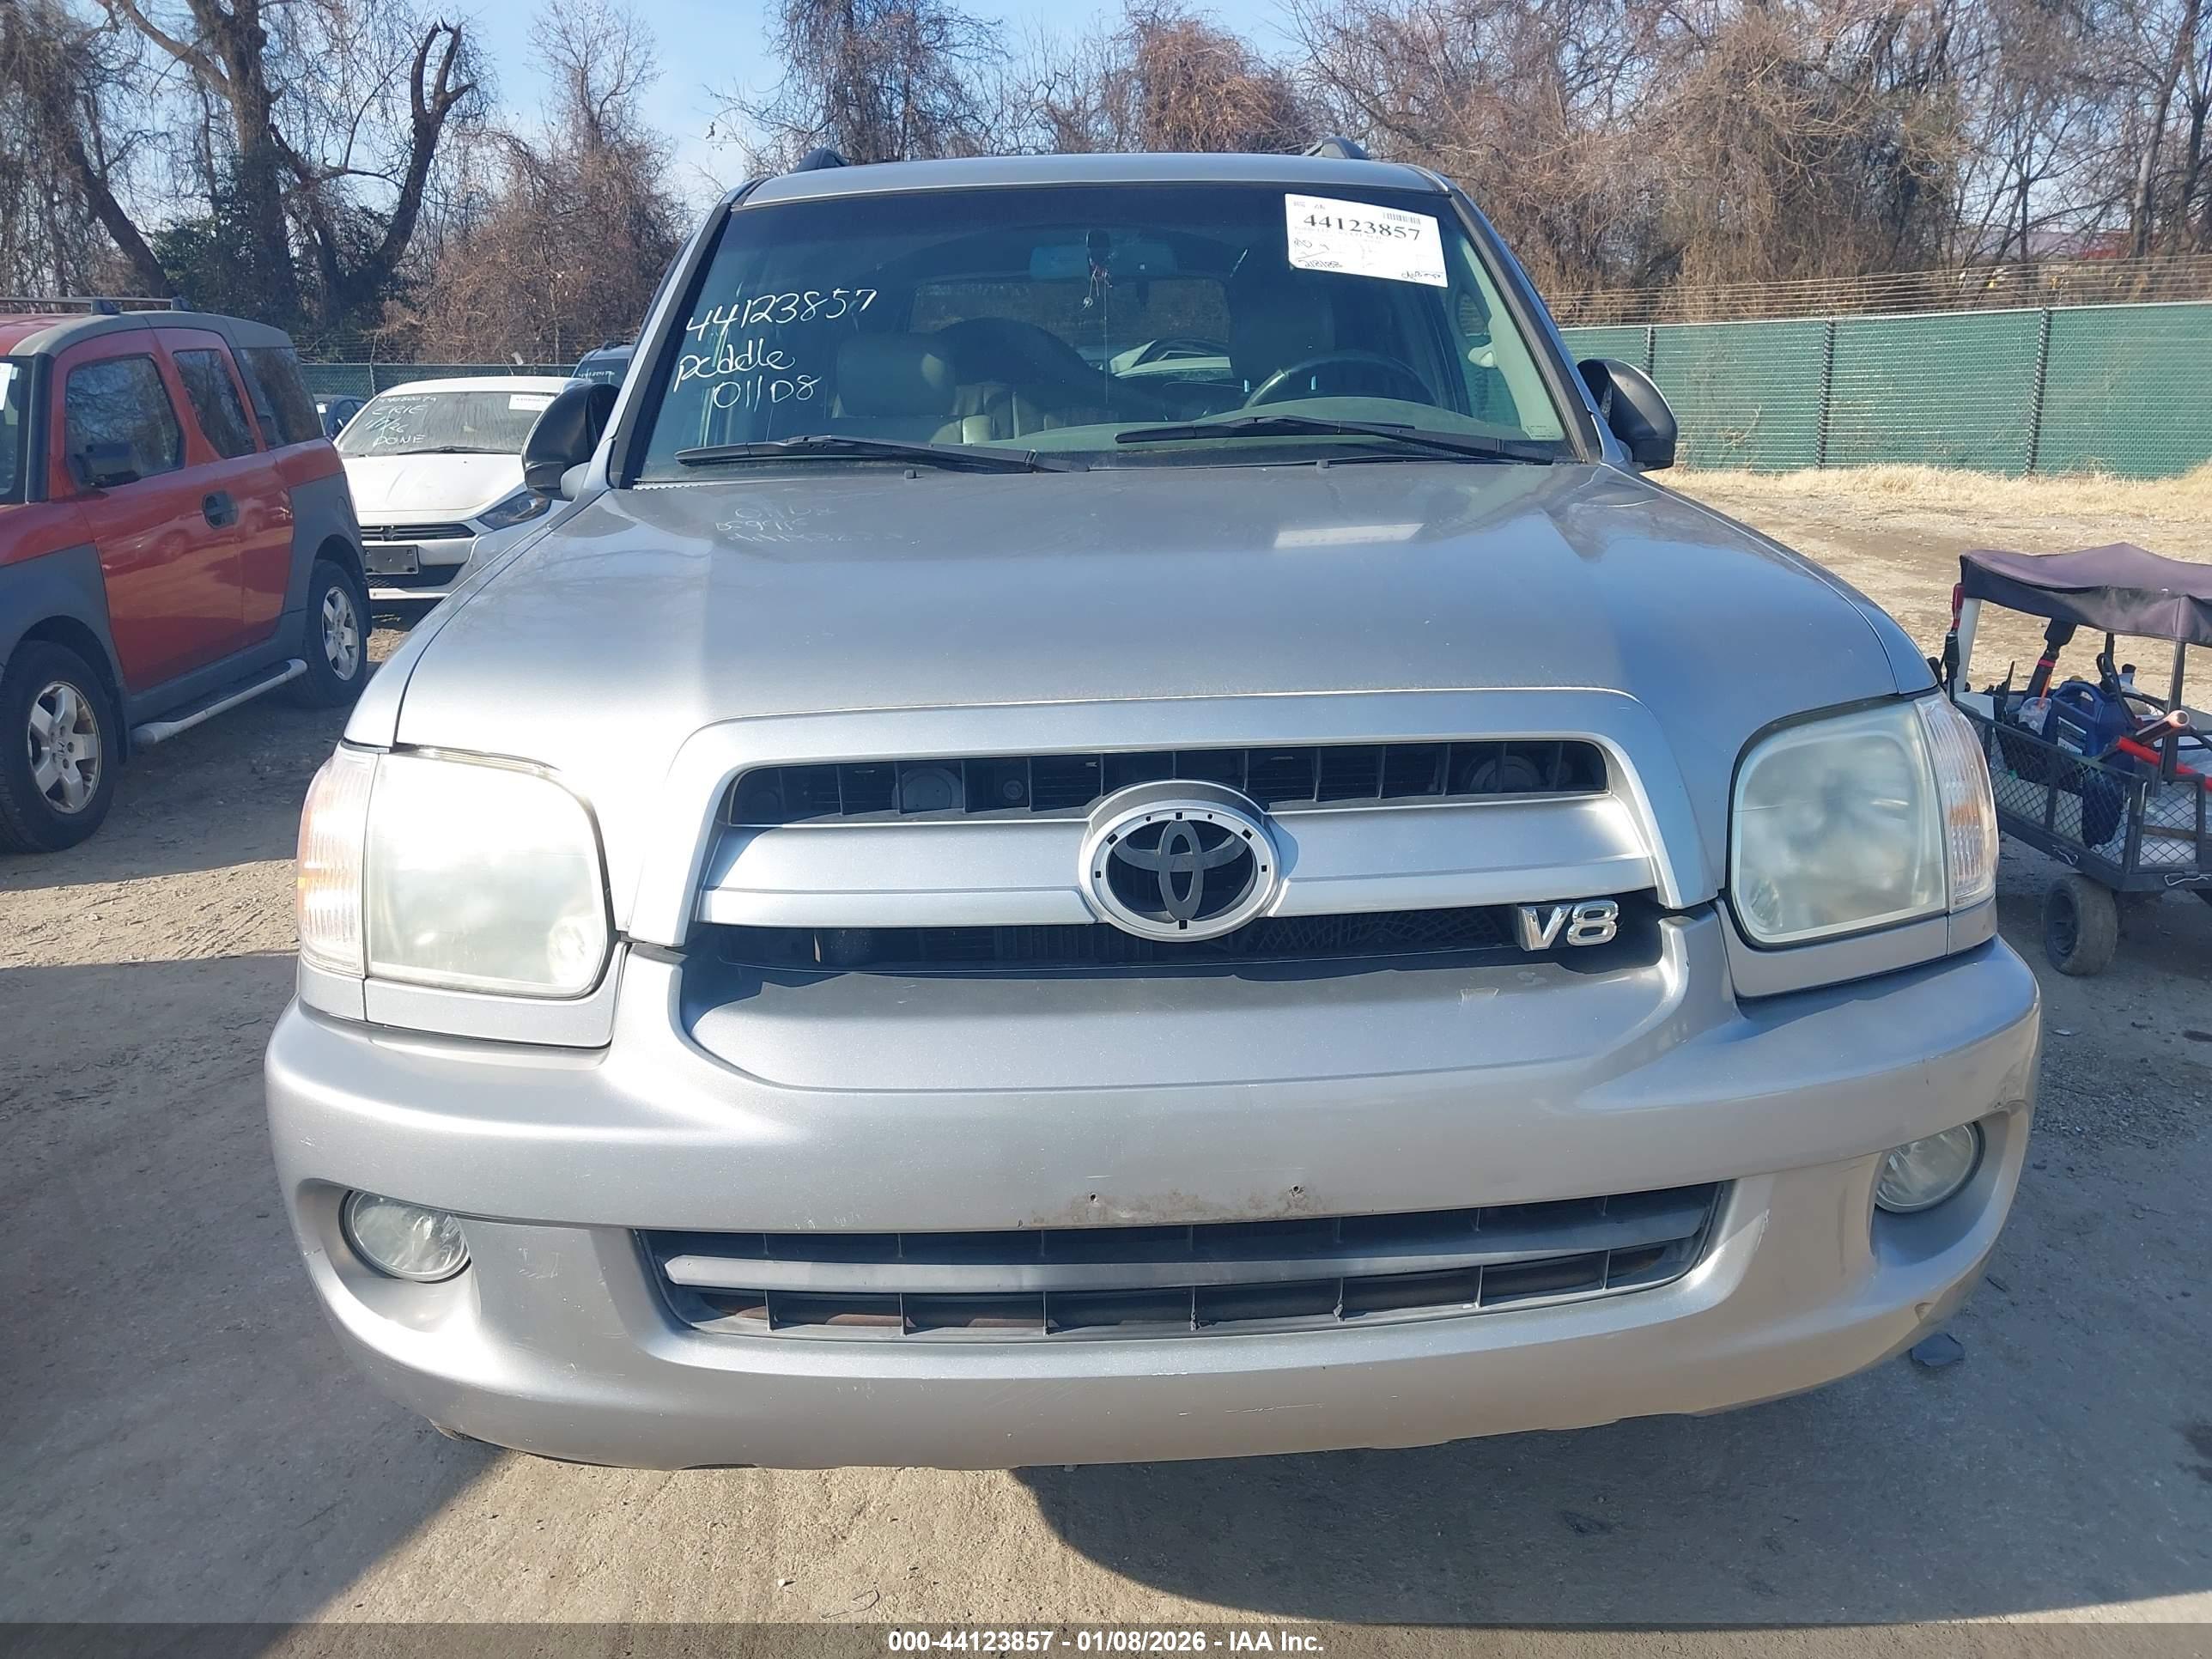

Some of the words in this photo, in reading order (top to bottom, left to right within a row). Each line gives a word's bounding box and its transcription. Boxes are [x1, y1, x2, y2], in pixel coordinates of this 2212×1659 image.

[1304, 214, 1421, 241] 44123857
[686, 289, 878, 341] 44123857
[373, 434, 427, 447] DONE
[1518, 901, 1620, 951] V8
